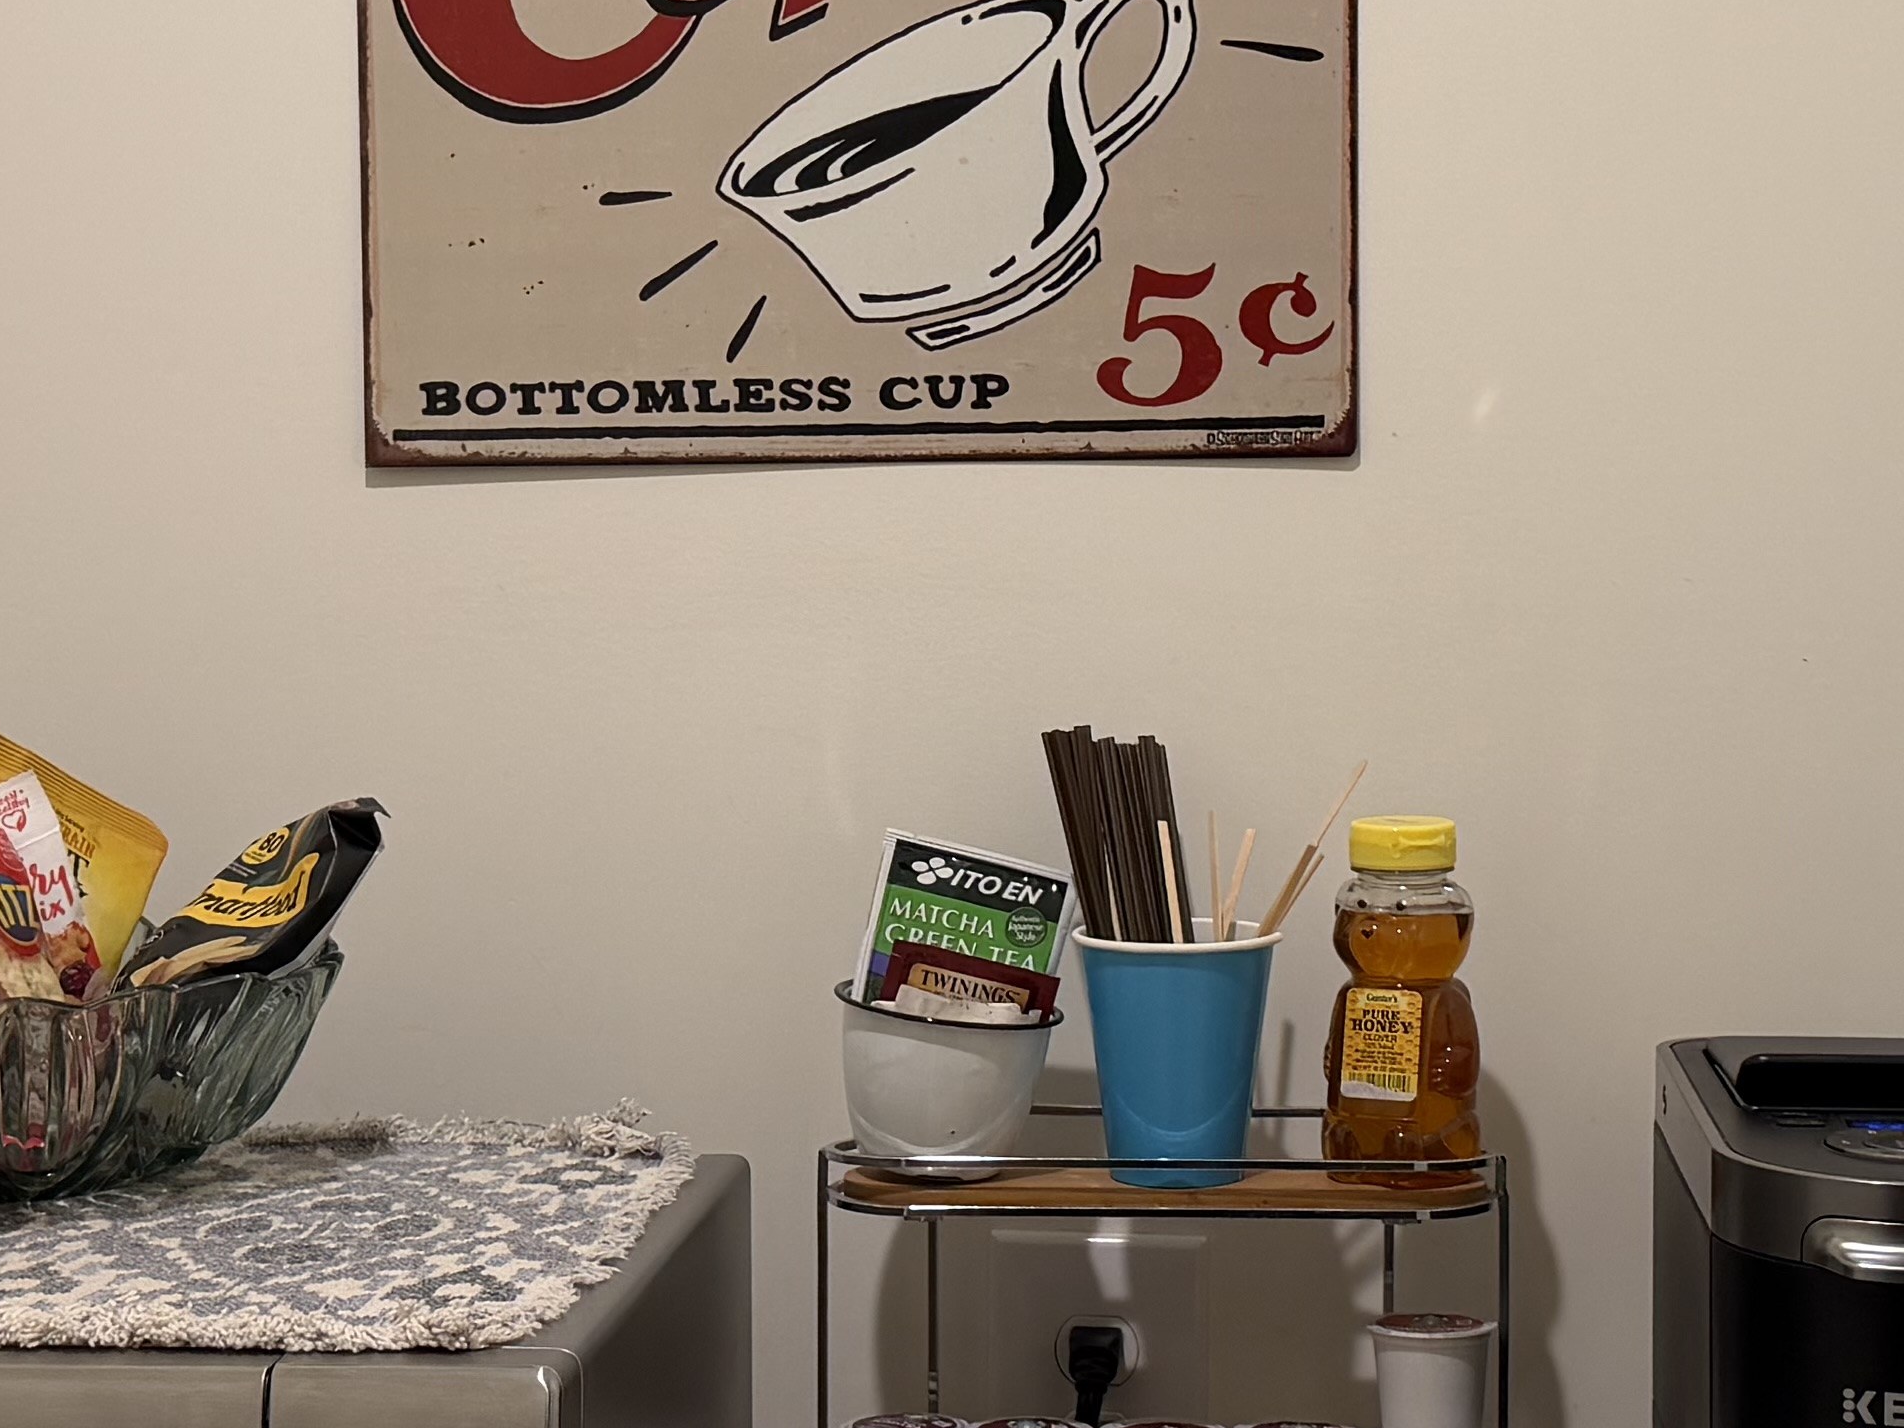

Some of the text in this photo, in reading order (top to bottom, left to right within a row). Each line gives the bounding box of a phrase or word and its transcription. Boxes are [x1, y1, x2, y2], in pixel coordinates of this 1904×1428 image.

[1096, 262, 1335, 407] 5¢
[420, 372, 1011, 417] BOTTOMLESS CUP
[258, 831, 285, 855] 80
[950, 868, 1044, 905] ITO EN
[889, 896, 995, 940] MATCHA
[920, 968, 1017, 1003] TWININGS
[1351, 1018, 1414, 1035] HONEY
